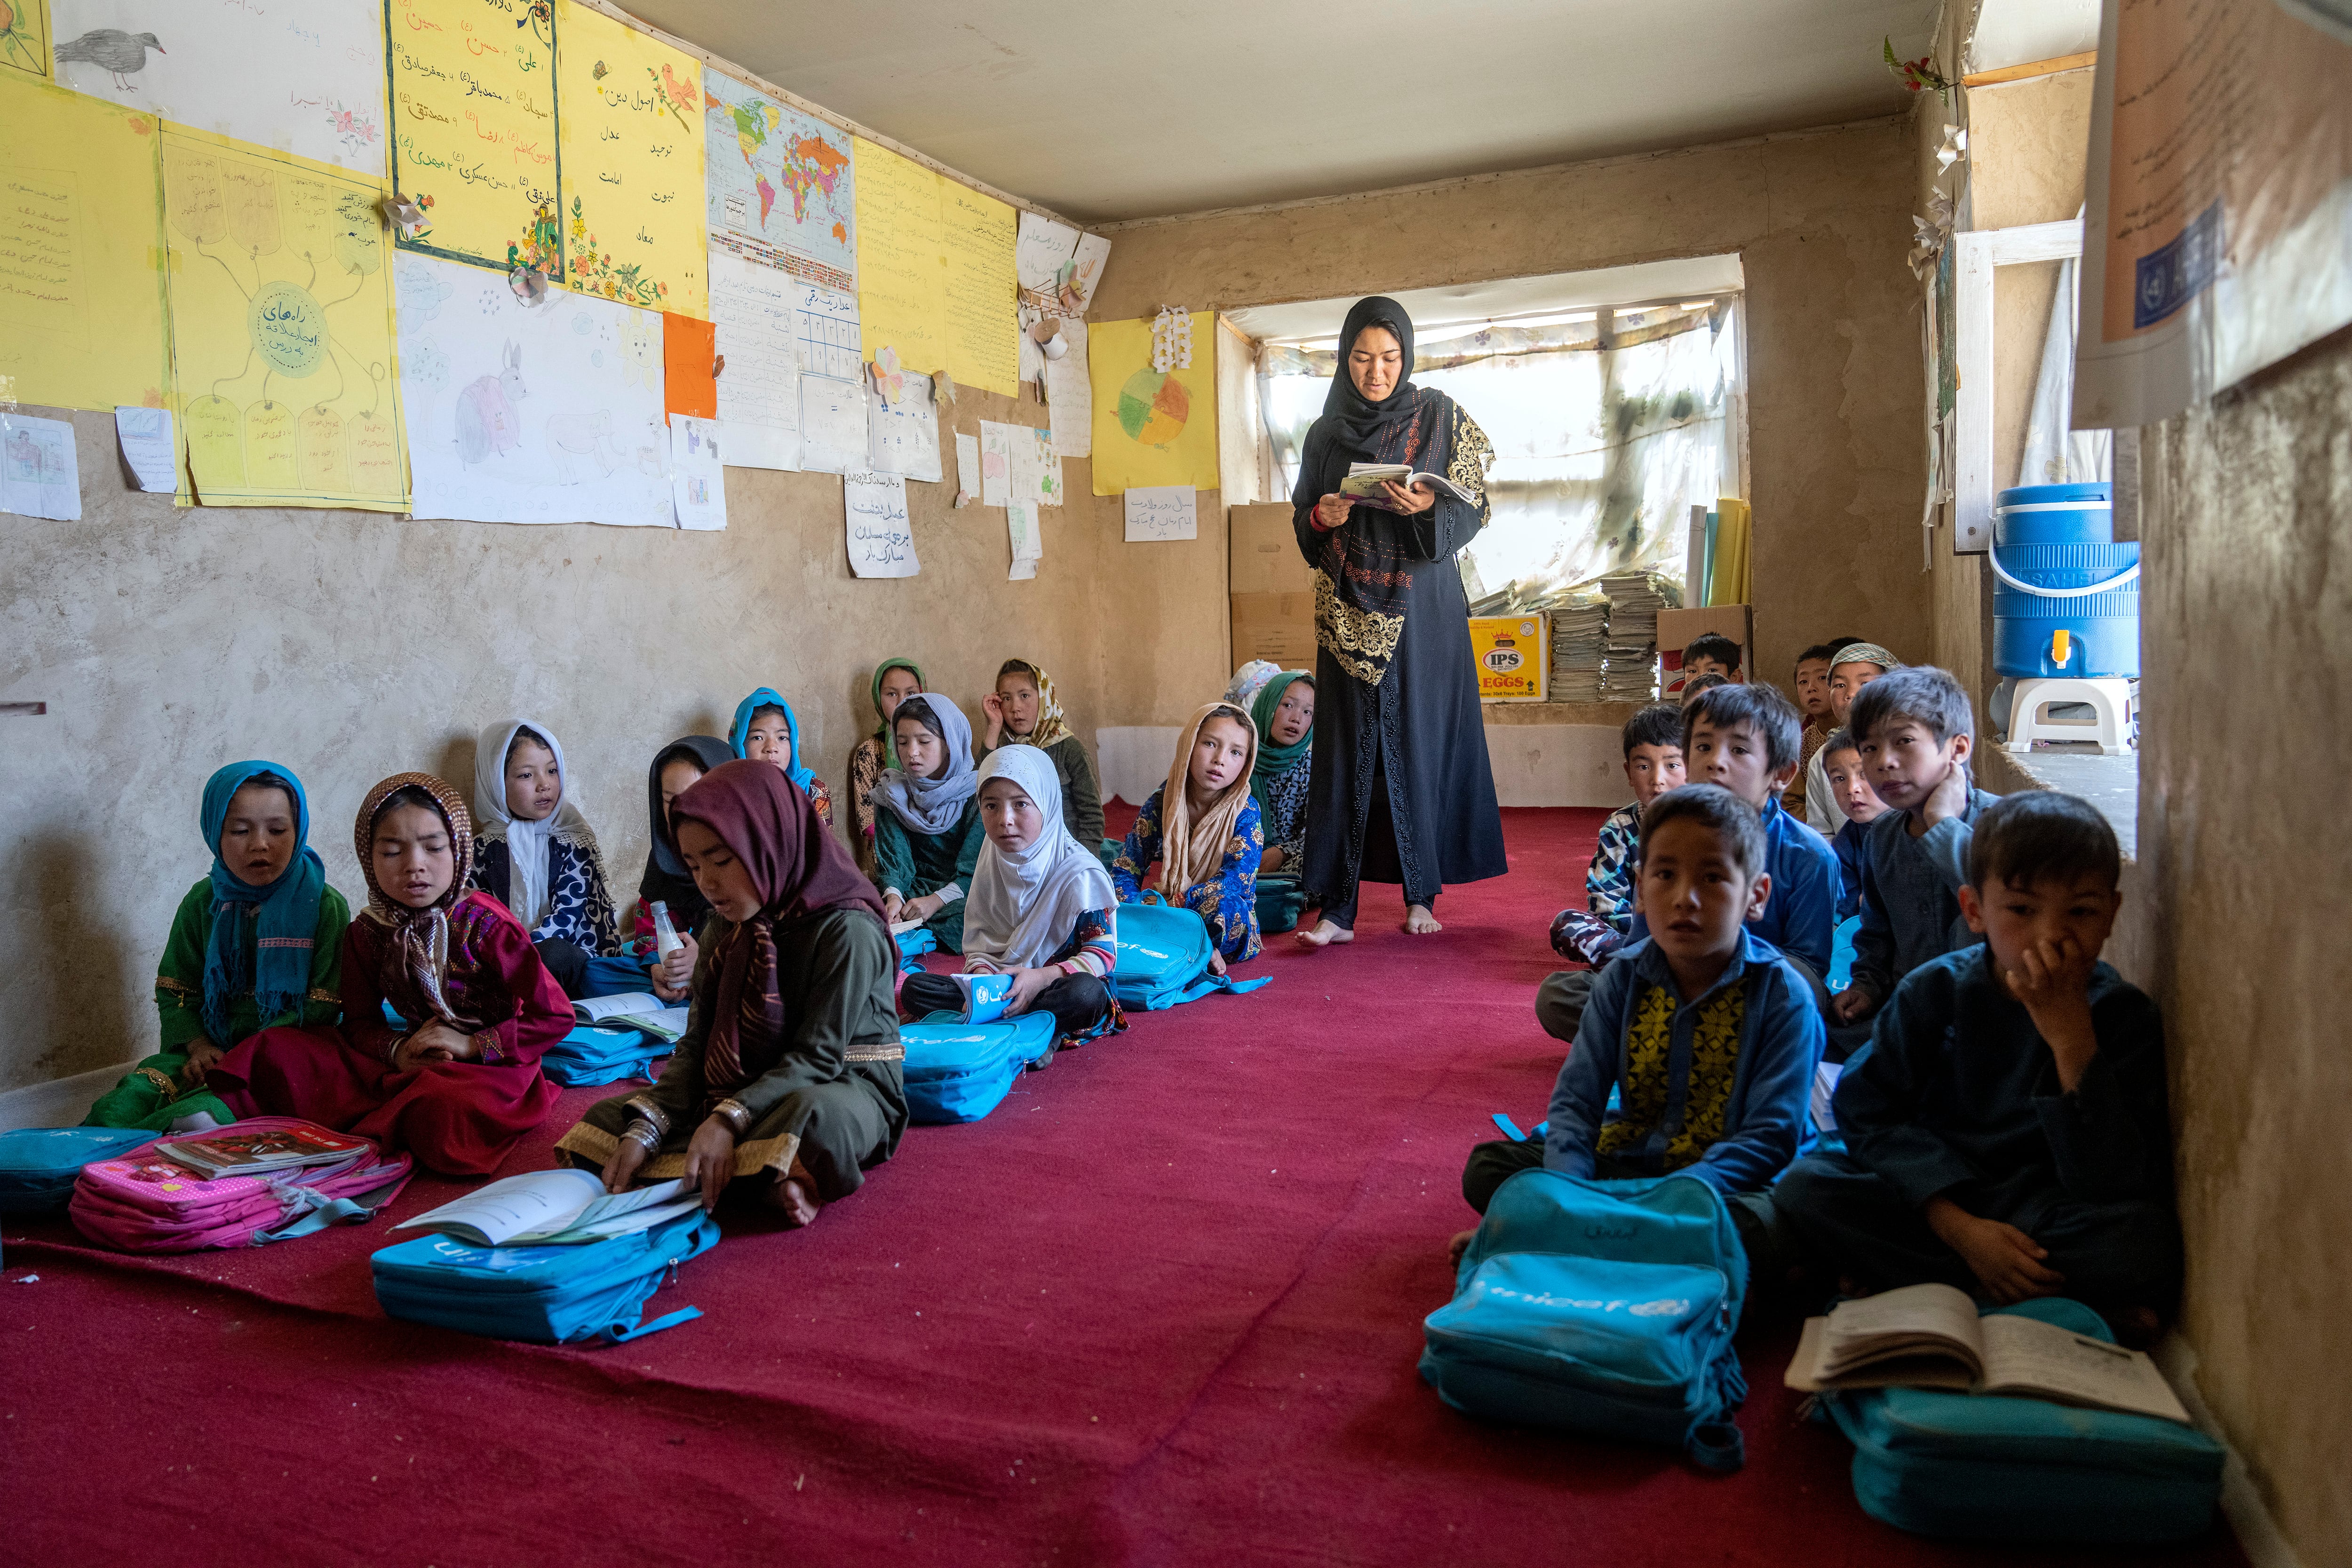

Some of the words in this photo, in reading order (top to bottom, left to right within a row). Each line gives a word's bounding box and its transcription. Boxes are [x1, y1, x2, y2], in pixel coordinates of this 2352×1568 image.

[406, 13, 443, 31] حسین
[286, 18, 309, 41] جهاد
[467, 37, 500, 56] حسن
[518, 50, 537, 72] علی
[605, 90, 628, 107] دین
[631, 90, 654, 112] اصول
[523, 98, 548, 119] سجاد
[600, 125, 620, 141] عدل
[650, 144, 673, 157] توحید
[409, 150, 445, 168] مهدی
[598, 171, 622, 185] امامت
[342, 194, 358, 202] کنید
[353, 197, 374, 210] ورزش
[652, 191, 675, 203] نبوت
[345, 213, 362, 222] خوری
[363, 217, 374, 229] سالم
[358, 235, 375, 247] خوب
[636, 225, 653, 244] معاد
[1021, 229, 1051, 254] معلم
[1047, 238, 1067, 252] روز
[805, 289, 818, 306] رقمی
[820, 295, 834, 311] یک
[266, 322, 296, 337] علاقه
[771, 321, 789, 334] شنبه
[816, 321, 820, 330] ۴
[829, 326, 834, 335] ۳
[295, 326, 317, 346] ایجاد
[842, 328, 845, 337] ۲
[269, 341, 292, 353] درس
[295, 347, 303, 357] به
[818, 351, 821, 359] ۹
[845, 358, 849, 366] ۷
[837, 390, 853, 399] علامت
[1131, 498, 1156, 509] ولادت
[1158, 501, 1171, 509] روز
[1172, 495, 1192, 512] سال
[883, 502, 905, 522] عید
[1158, 517, 1176, 525] زمان
[1178, 517, 1191, 530] امام
[1156, 528, 1167, 538] باد
[898, 534, 909, 547] بر
[866, 542, 875, 561] باد
[876, 543, 904, 564] مبارک
[1490, 653, 1519, 665] IPS
[1483, 677, 1524, 689] EGGS
